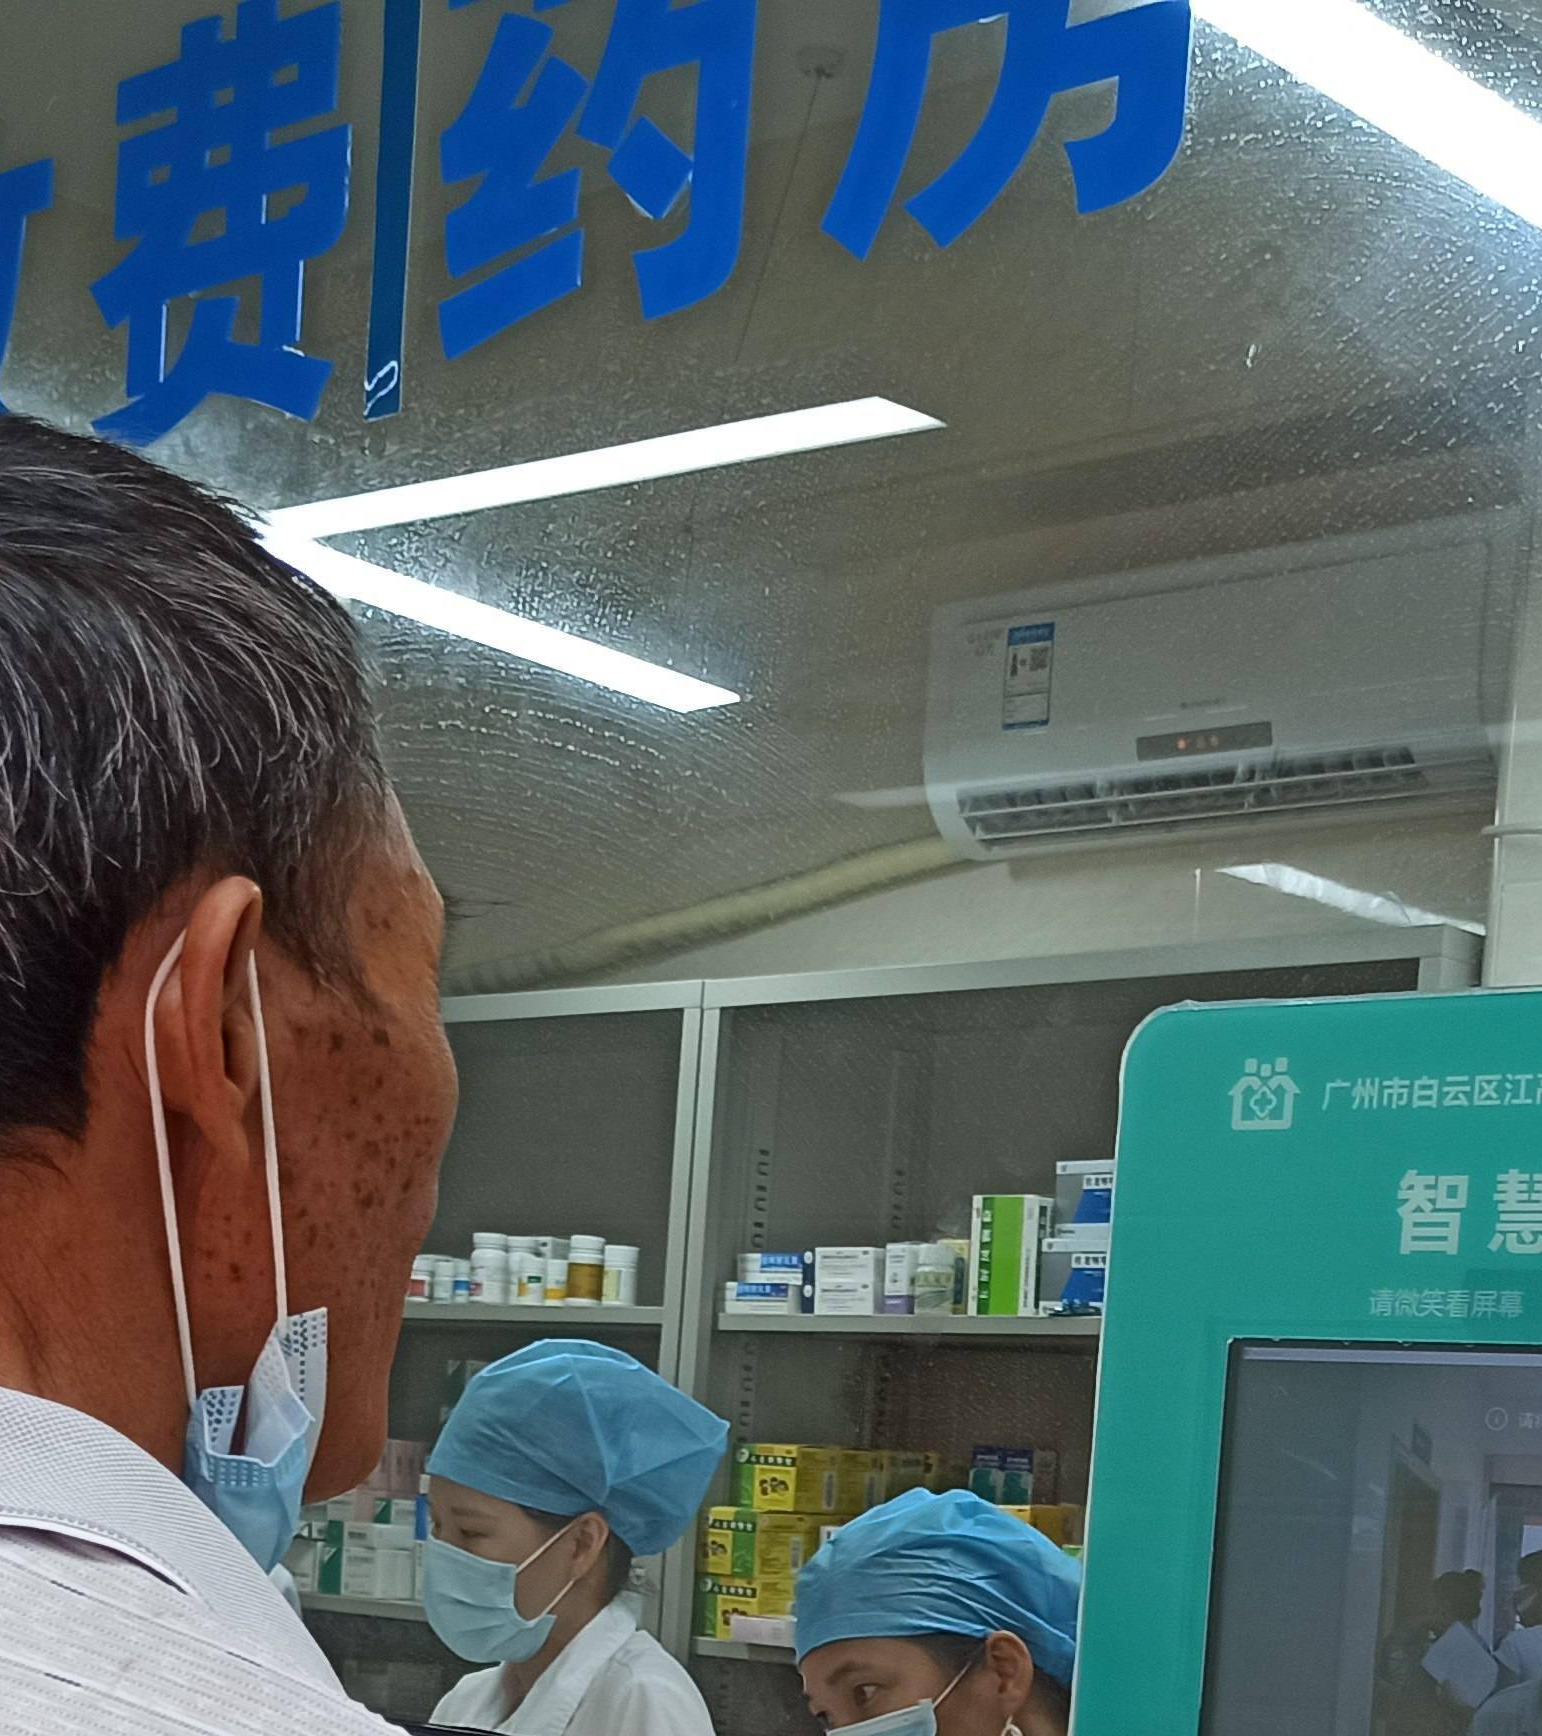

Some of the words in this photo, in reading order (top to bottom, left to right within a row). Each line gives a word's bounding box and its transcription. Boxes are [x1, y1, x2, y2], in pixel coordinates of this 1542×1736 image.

[1369, 1288, 1524, 1319] 请微笑看屏幕
